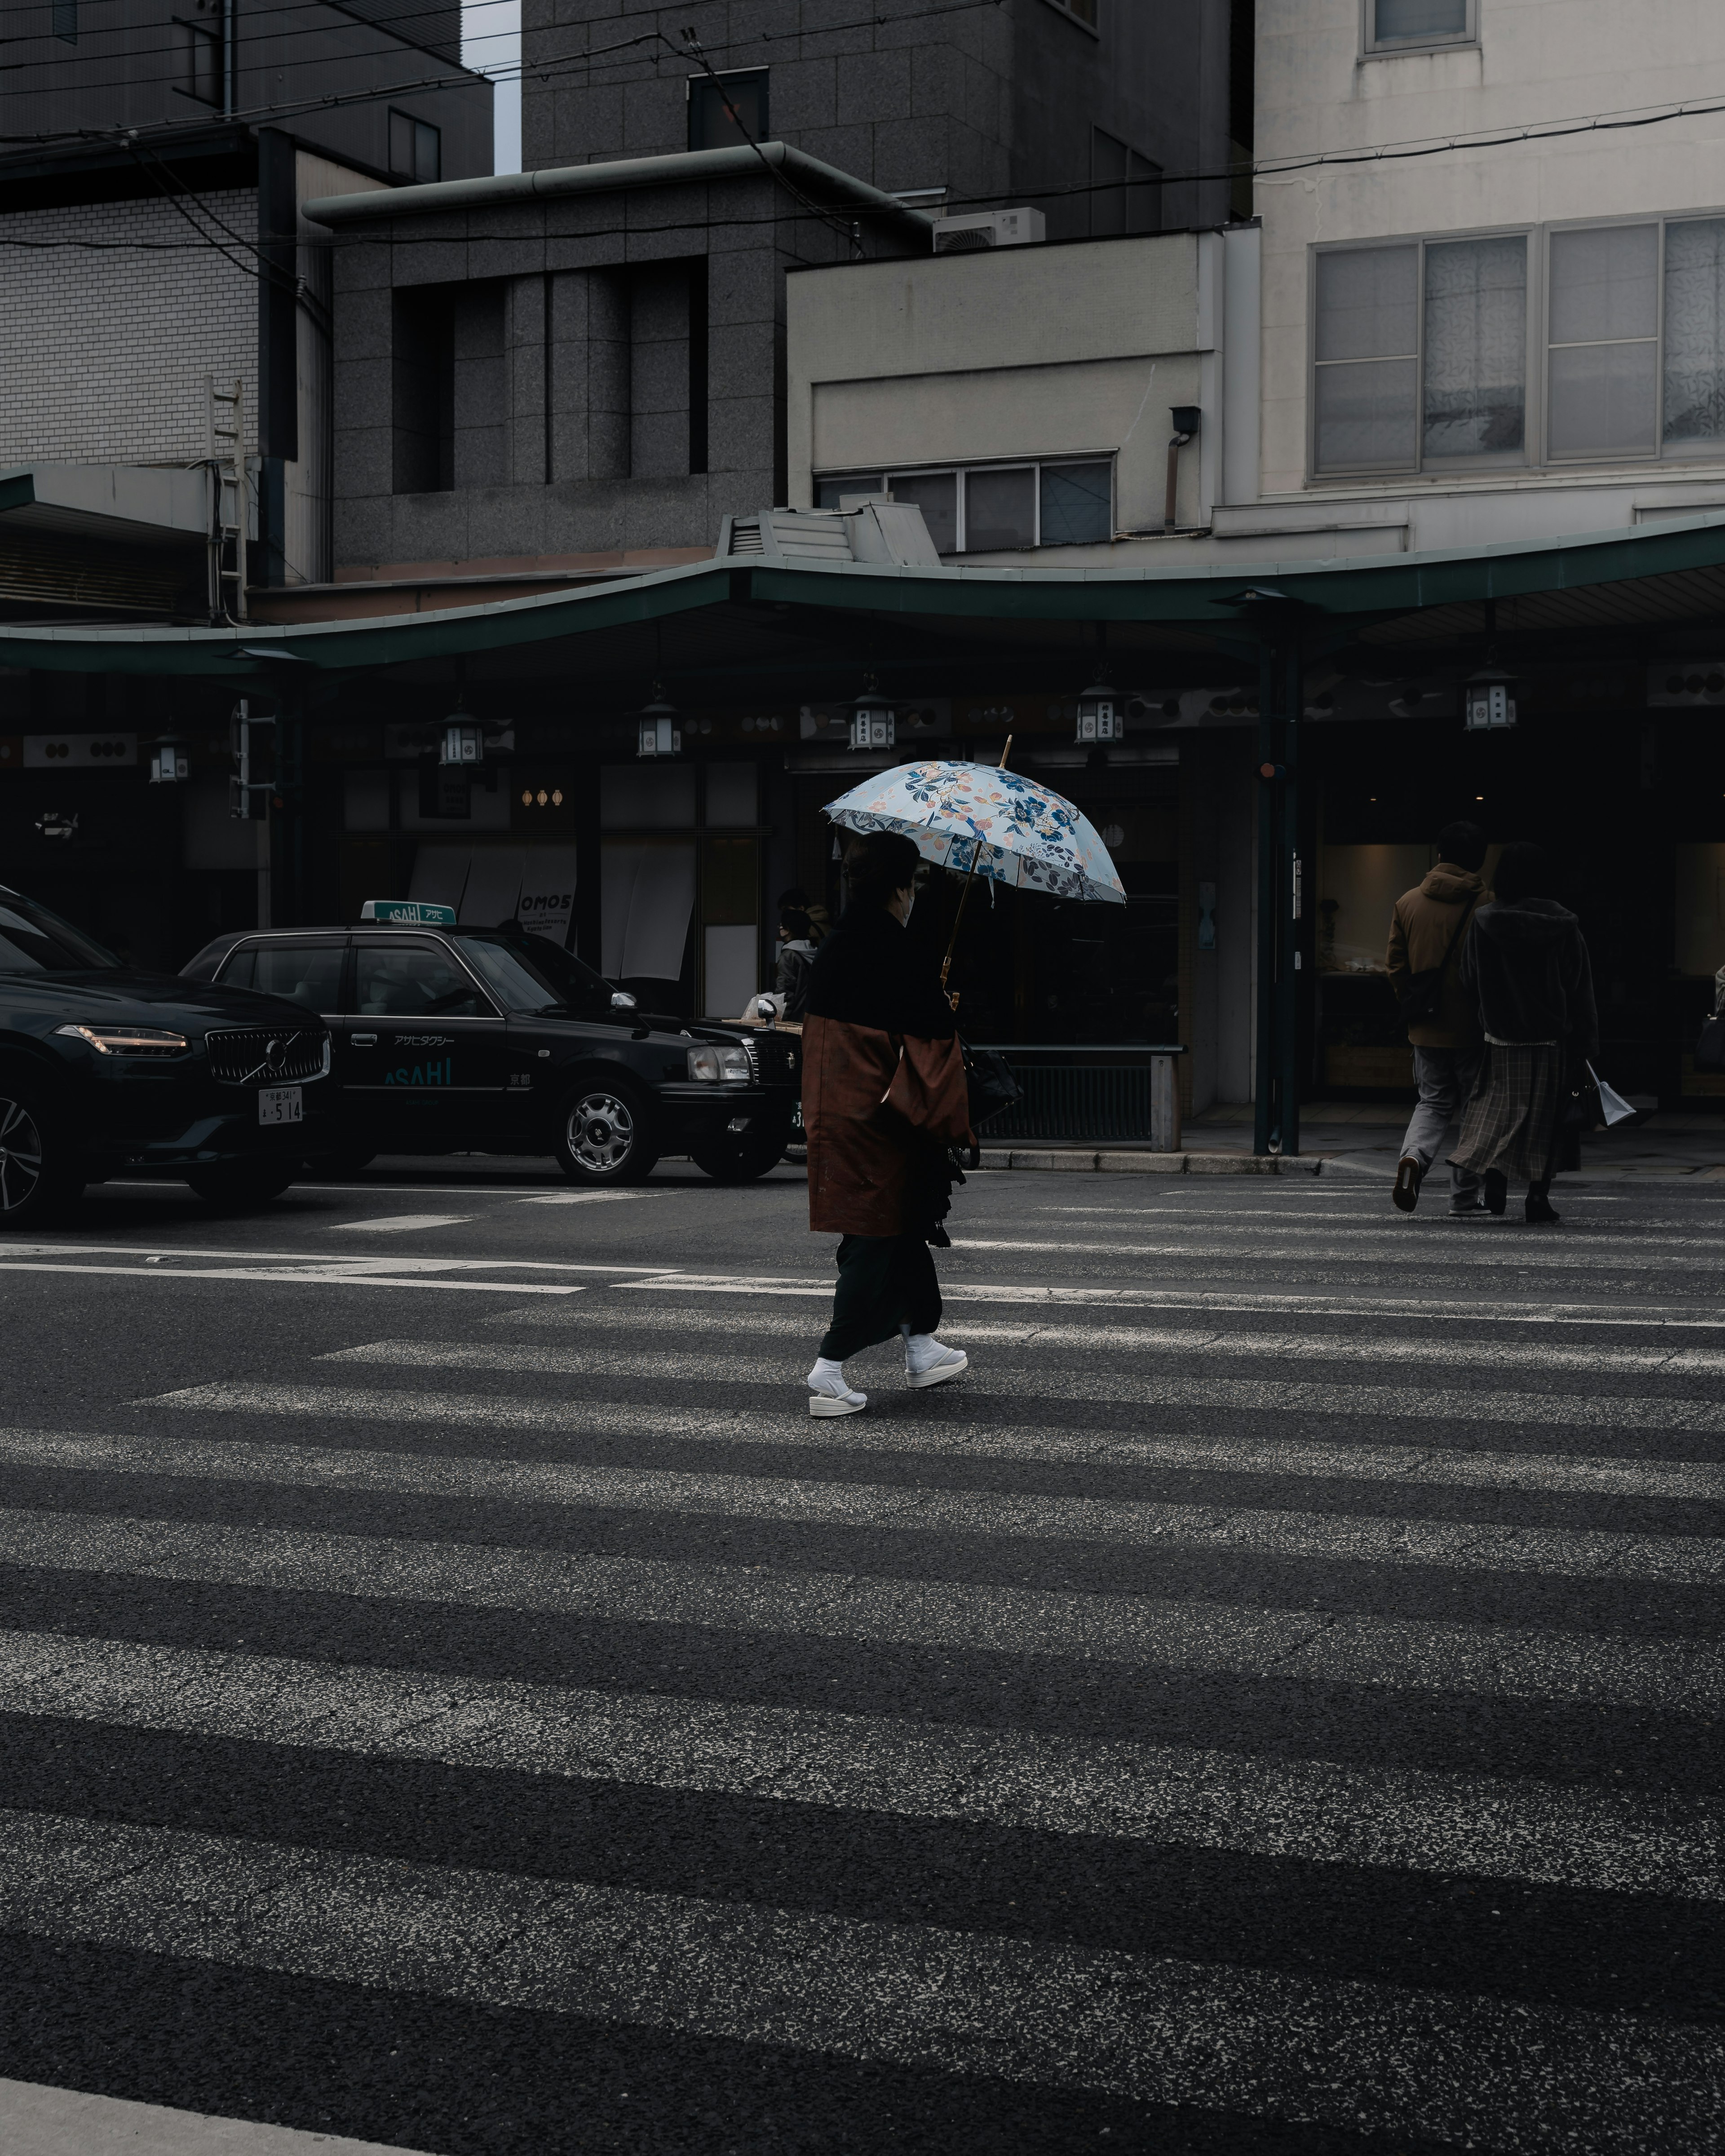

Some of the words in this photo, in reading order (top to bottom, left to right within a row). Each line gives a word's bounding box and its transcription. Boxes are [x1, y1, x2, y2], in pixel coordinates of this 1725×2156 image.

[522, 895, 571, 910] OMO5
[425, 909, 443, 919] アサヒ
[394, 1035, 455, 1046] アサヒタクシー
[384, 1057, 451, 1085] ASAHI
[510, 1074, 531, 1085] 京都
